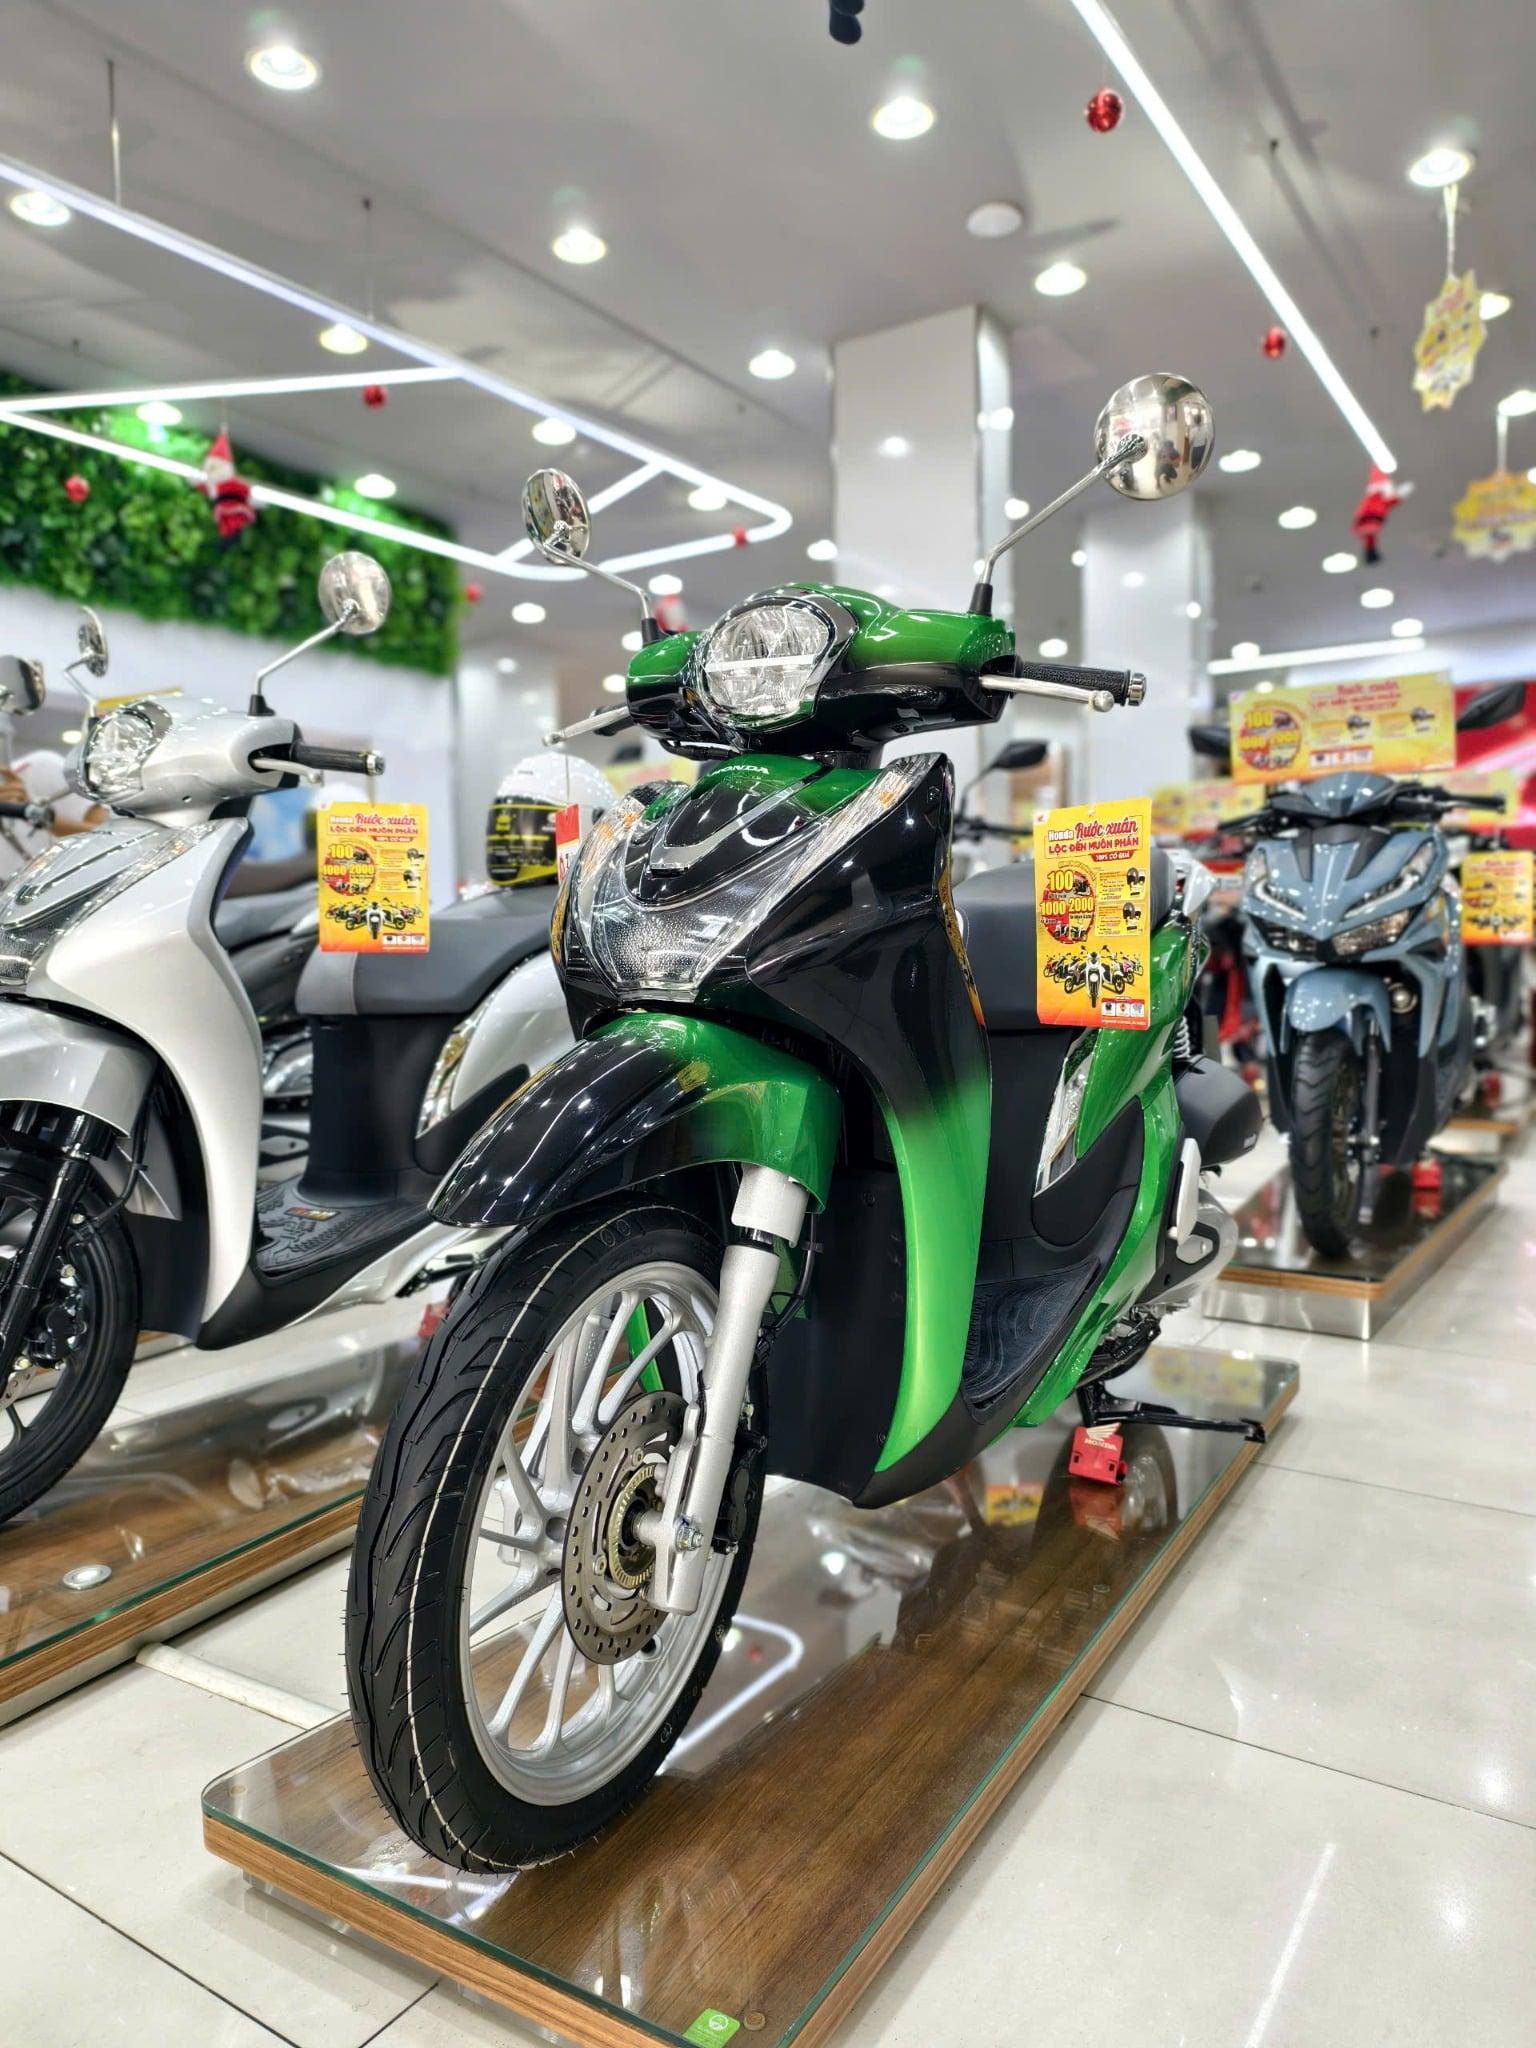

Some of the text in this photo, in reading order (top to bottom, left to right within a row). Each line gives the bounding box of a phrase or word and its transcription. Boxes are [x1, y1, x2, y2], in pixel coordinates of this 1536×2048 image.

[355, 813, 384, 825] Rước
[387, 815, 416, 825] xuân
[1048, 817, 1138, 842] Honda Rước xuân
[328, 843, 354, 860] 100
[1048, 843, 1068, 856] LỘC
[1069, 838, 1087, 853] ĐẾN
[1088, 837, 1113, 851] MUÔN
[1047, 869, 1074, 893] 100
[1039, 901, 1067, 917] 1000
[1068, 896, 1095, 913] 2000
